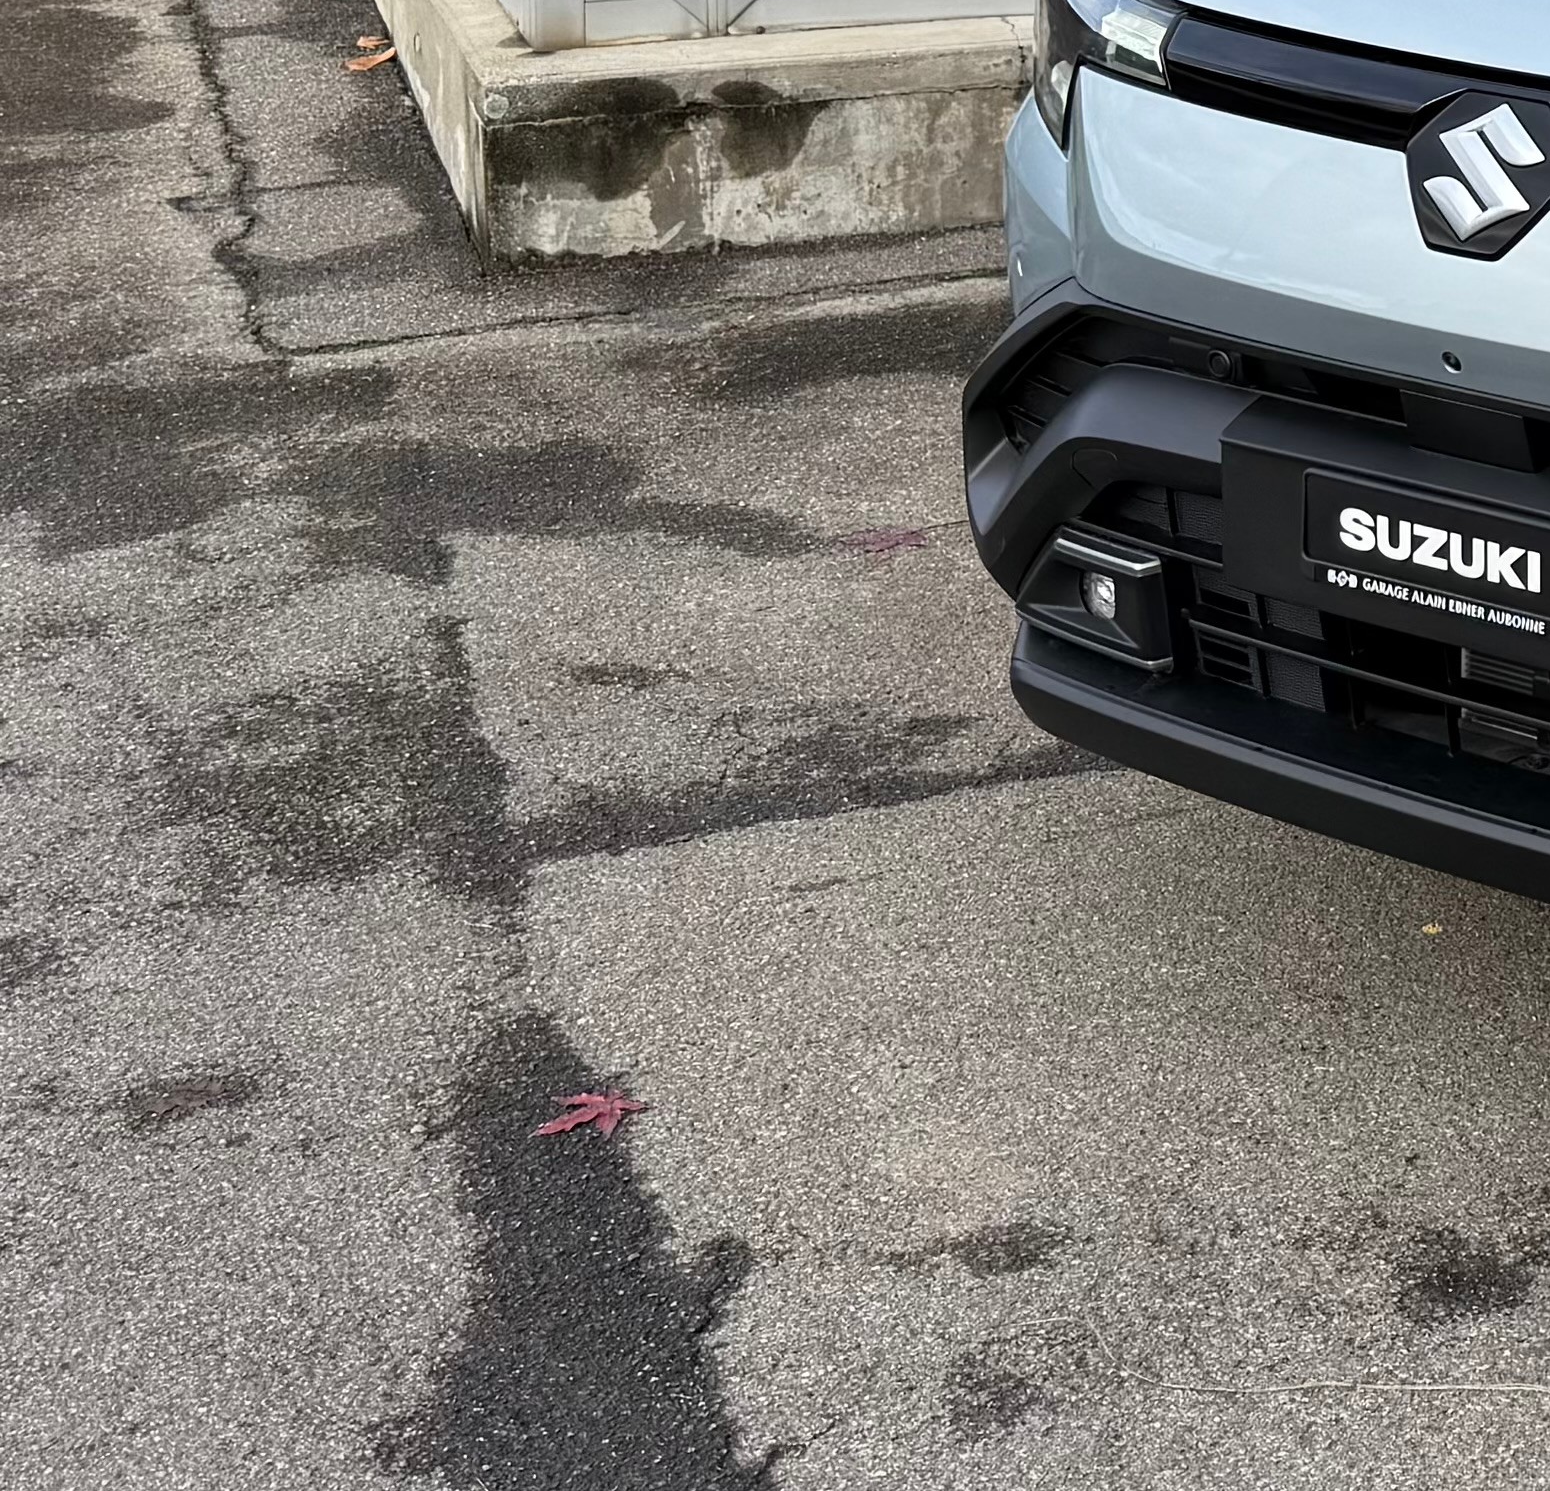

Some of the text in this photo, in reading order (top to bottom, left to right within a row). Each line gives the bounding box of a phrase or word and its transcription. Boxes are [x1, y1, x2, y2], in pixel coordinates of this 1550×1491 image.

[1339, 507, 1542, 594] SUZUKI
[1362, 578, 1546, 636] GARAGE ALAIN EBNER AUBONNE
